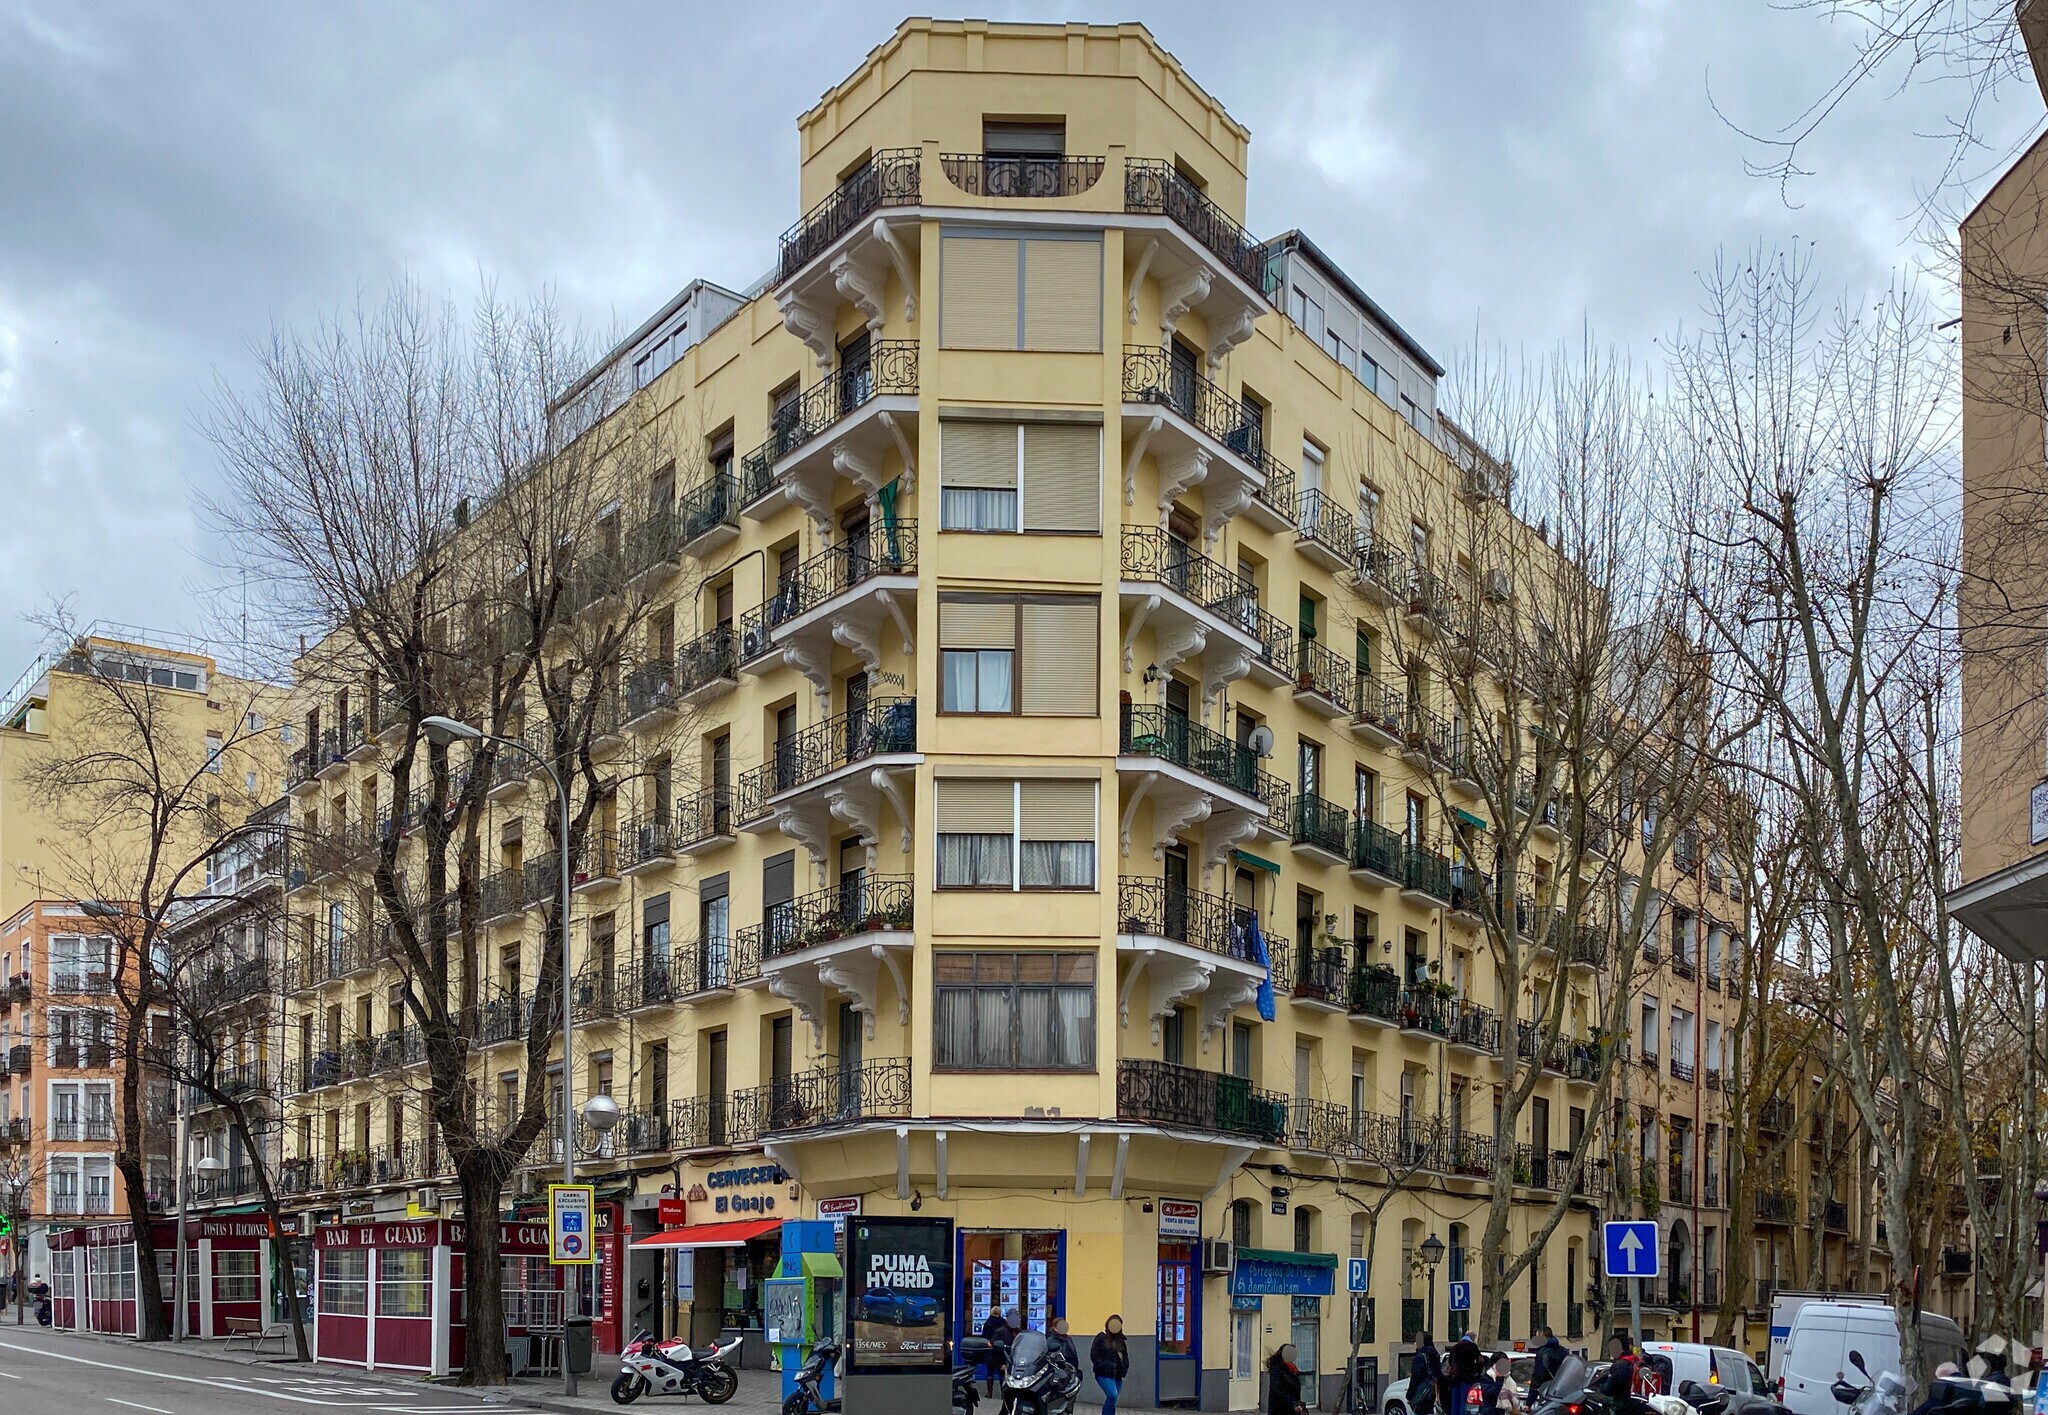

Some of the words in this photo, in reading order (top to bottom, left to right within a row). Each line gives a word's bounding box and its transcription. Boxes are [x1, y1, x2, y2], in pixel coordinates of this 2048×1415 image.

[715, 1196, 727, 1213] El
[732, 1194, 774, 1213] Guaje
[203, 1222, 227, 1236] TOSTAS
[229, 1223, 234, 1236] Y
[236, 1223, 268, 1237] RACIONES
[280, 1222, 295, 1232] range
[325, 1229, 349, 1246] BAR
[360, 1228, 376, 1245] EL
[385, 1226, 427, 1244] GUAJE
[450, 1225, 467, 1243] BA
[518, 1226, 550, 1245] GUA
[871, 1254, 929, 1271] PUMA
[866, 1271, 934, 1289] HYBRID
[1249, 1262, 1282, 1283] Arreglos
[1286, 1265, 1294, 1277] de
[1353, 1261, 1361, 1287] P
[1454, 1284, 1464, 1306] P
[900, 1341, 919, 1350] Ford
